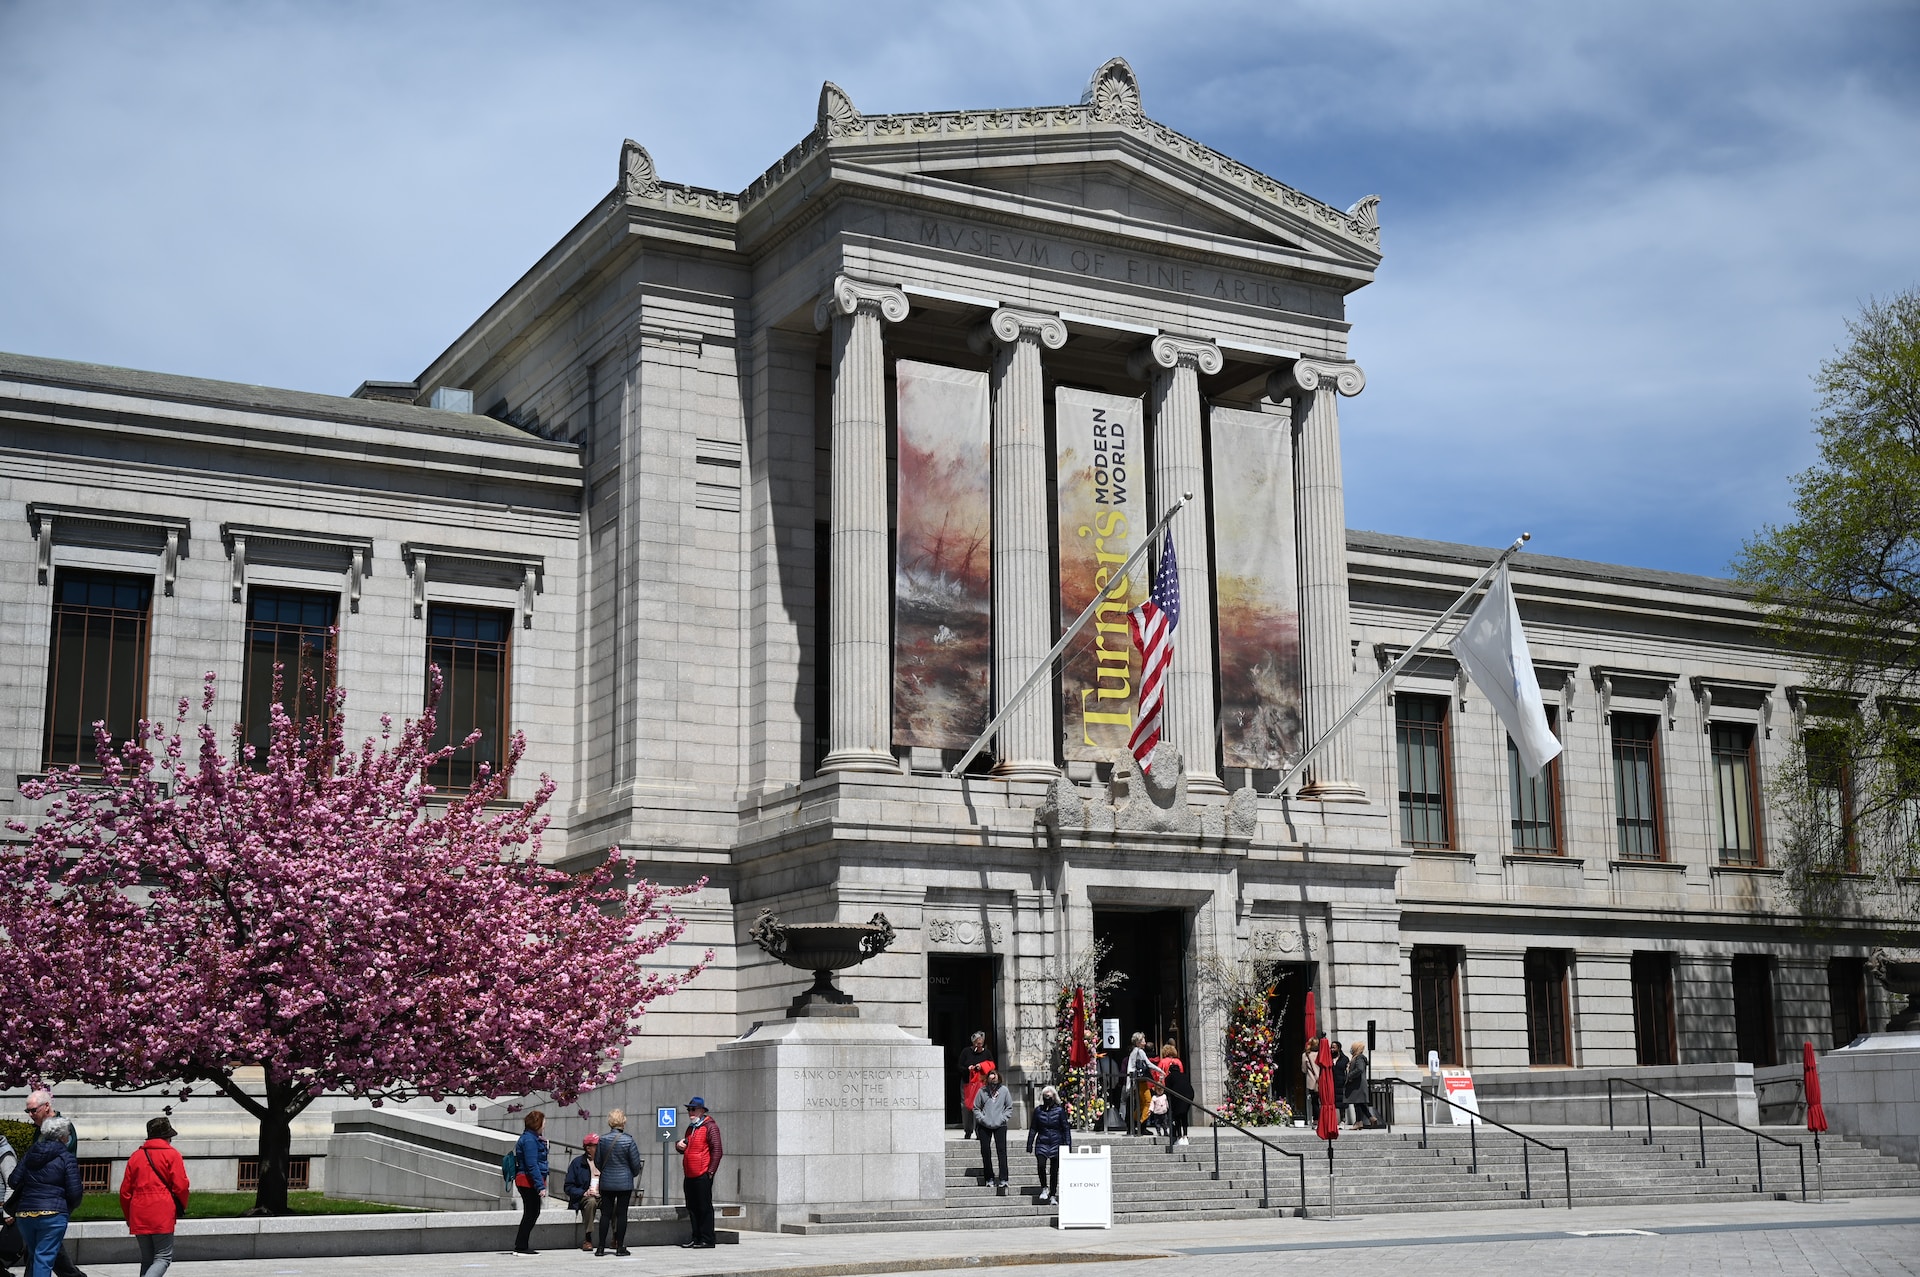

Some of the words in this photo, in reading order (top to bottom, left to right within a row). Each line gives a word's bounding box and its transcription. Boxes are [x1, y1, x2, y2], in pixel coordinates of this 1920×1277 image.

[920, 222, 1049, 265] MVSEVM
[1071, 250, 1105, 274] OF
[1128, 259, 1195, 291] FINE
[1213, 278, 1282, 307] ARTS
[1092, 408, 1109, 505] MODERN
[1111, 423, 1127, 505] WORLD
[1078, 511, 1132, 747] Turner's
[929, 976, 950, 984] ONLY
[794, 1070, 823, 1080] BANK
[828, 1070, 842, 1080] OF
[847, 1070, 893, 1080] AMERICA
[896, 1070, 930, 1080] PLAZA
[842, 1084, 859, 1093] ON
[863, 1084, 884, 1093] THE
[806, 1098, 848, 1107] AVENUE
[851, 1098, 865, 1107] OF
[868, 1098, 889, 1107] THE
[892, 1098, 918, 1107] ARTS
